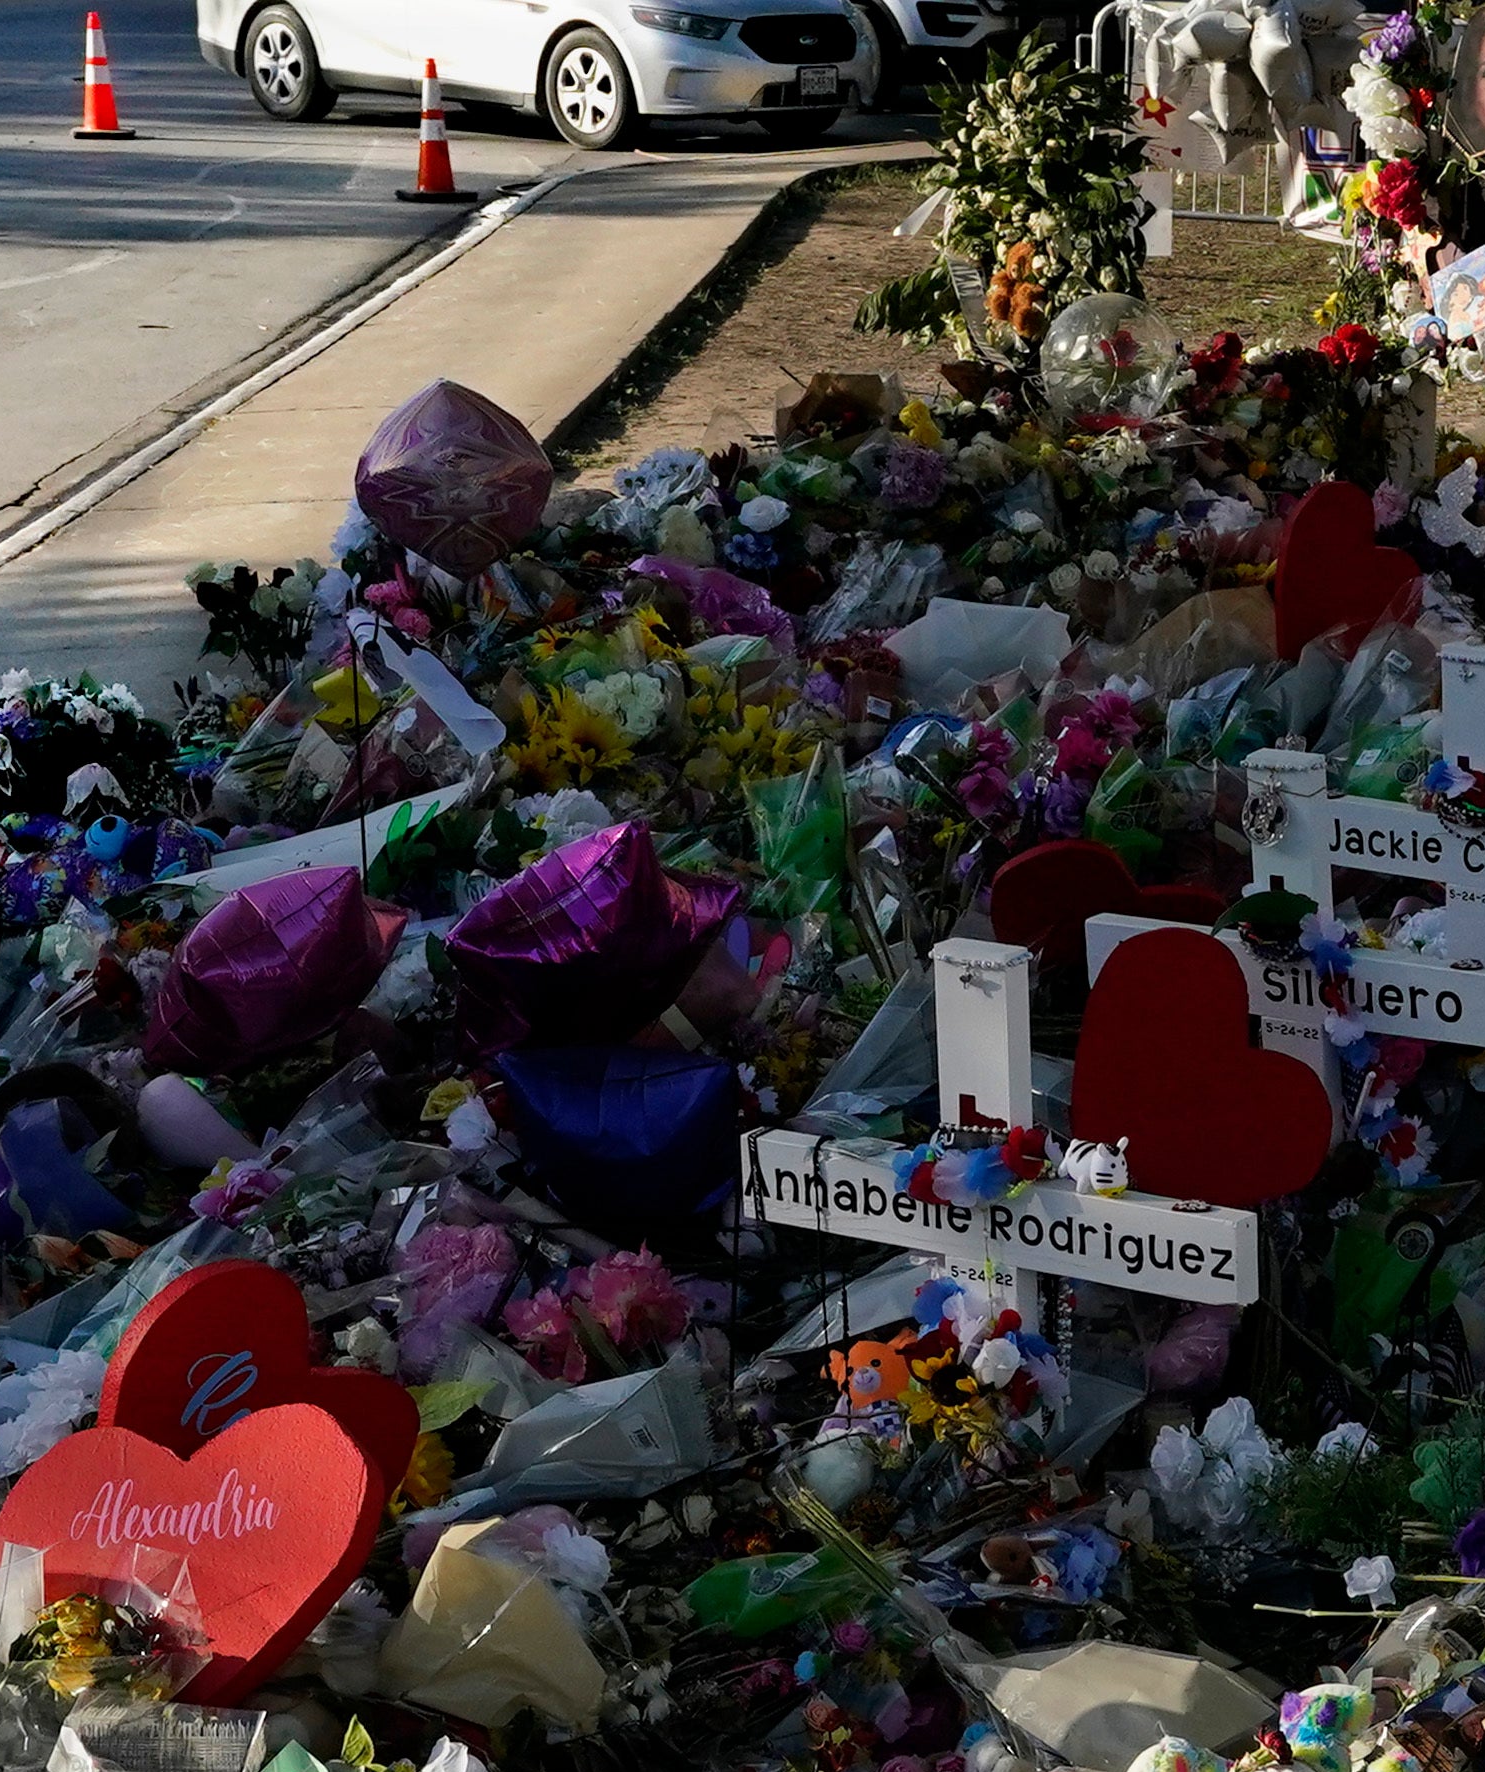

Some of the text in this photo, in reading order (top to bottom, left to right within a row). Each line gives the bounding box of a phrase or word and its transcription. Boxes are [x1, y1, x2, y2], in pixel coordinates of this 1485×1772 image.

[1330, 816, 1442, 866] Jackie
[1265, 1018, 1320, 1042] 5-24-22
[744, 1157, 1235, 1284] Annabelle Rodriguez
[949, 1262, 1014, 1288] 5-24-22
[70, 1468, 282, 1550] Alexandria
